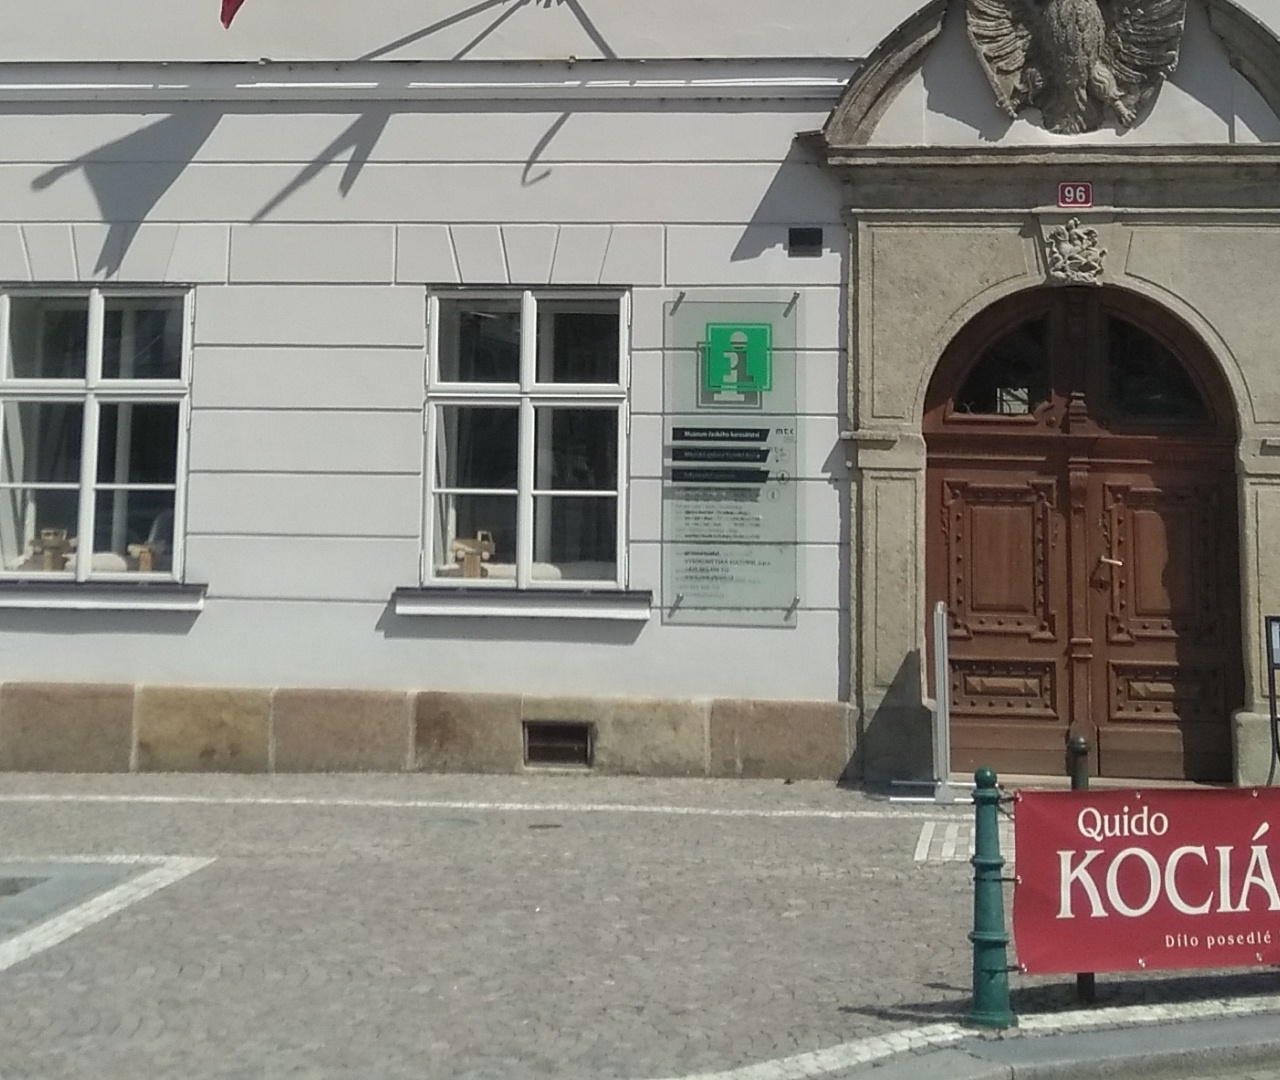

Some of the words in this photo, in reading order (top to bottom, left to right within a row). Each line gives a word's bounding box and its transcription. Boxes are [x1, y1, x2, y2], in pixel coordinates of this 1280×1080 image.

[1064, 186, 1086, 203] 96
[1077, 805, 1169, 842] Quido
[1165, 931, 1199, 948] Dílo
[1207, 928, 1271, 949] posedlé
